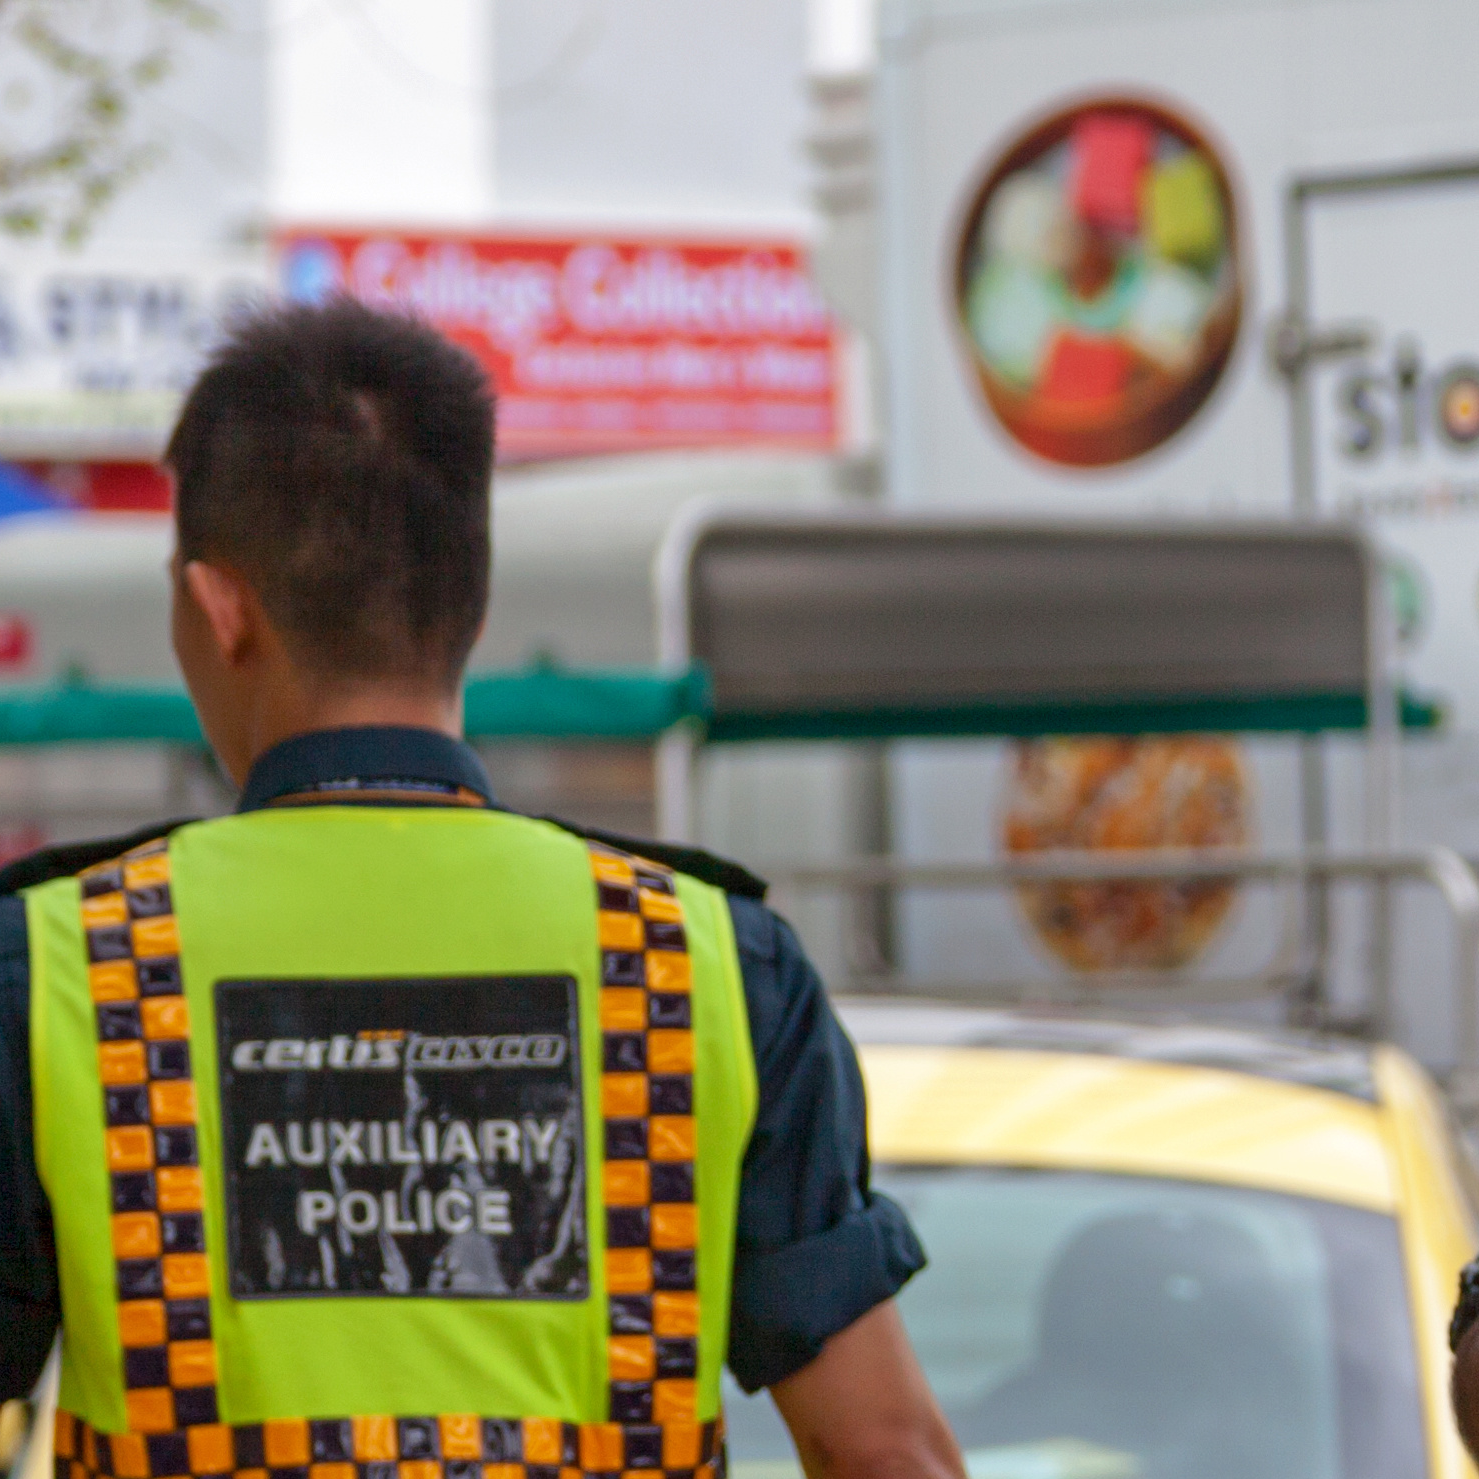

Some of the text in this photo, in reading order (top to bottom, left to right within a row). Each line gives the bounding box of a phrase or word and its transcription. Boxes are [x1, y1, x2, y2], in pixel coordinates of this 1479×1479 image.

[231, 1030, 406, 1071] certis
[245, 1118, 559, 1167] AUXILIARY
[300, 1190, 513, 1235] POLICE
